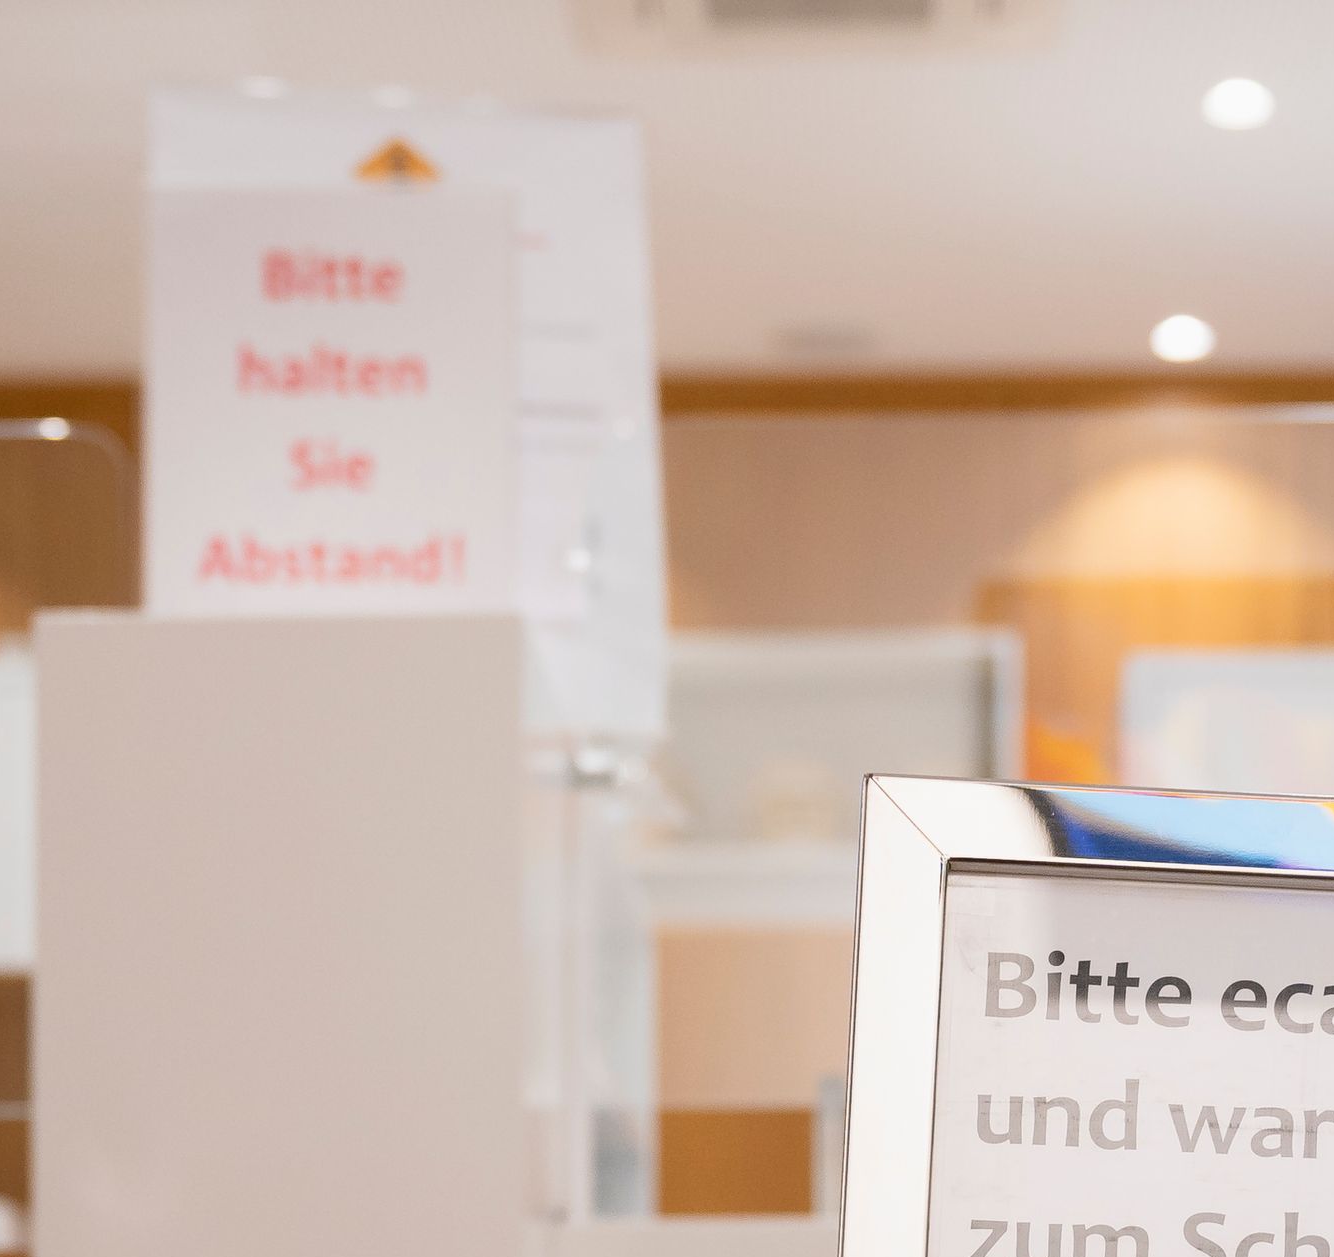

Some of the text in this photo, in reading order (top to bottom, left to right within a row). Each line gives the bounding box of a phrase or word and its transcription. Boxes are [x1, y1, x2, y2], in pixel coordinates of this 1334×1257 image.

[260, 245, 404, 302] Bitte
[236, 341, 429, 395] halten
[289, 437, 375, 492] Sie
[196, 532, 469, 584] Abstand!
[984, 948, 1193, 1028] Bitte
[975, 1077, 1141, 1152] und
